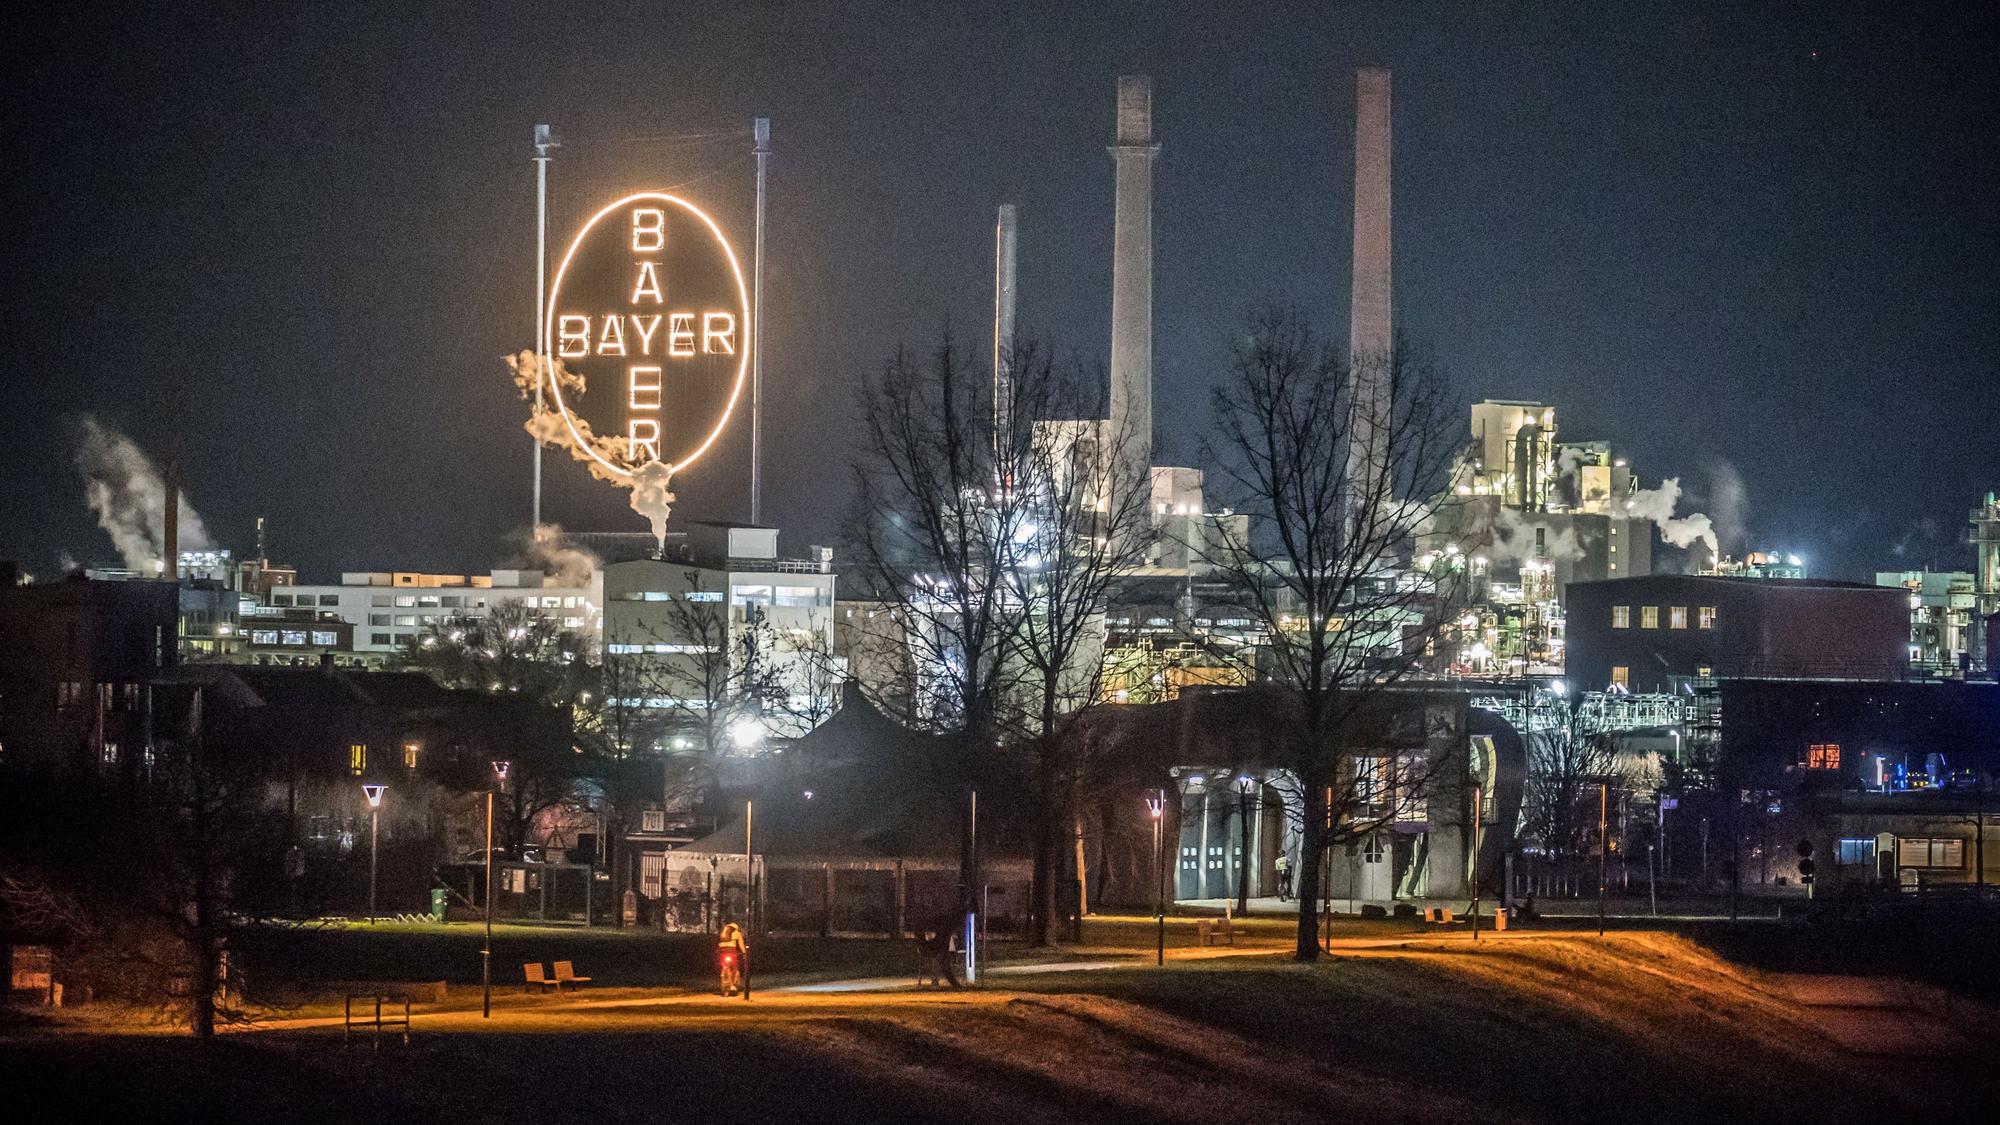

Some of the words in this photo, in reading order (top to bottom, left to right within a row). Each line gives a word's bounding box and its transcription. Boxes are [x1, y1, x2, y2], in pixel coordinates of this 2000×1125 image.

[558, 312, 735, 357] BAYER
[630, 208, 664, 462] BAYER
[644, 812, 661, 829] 701
